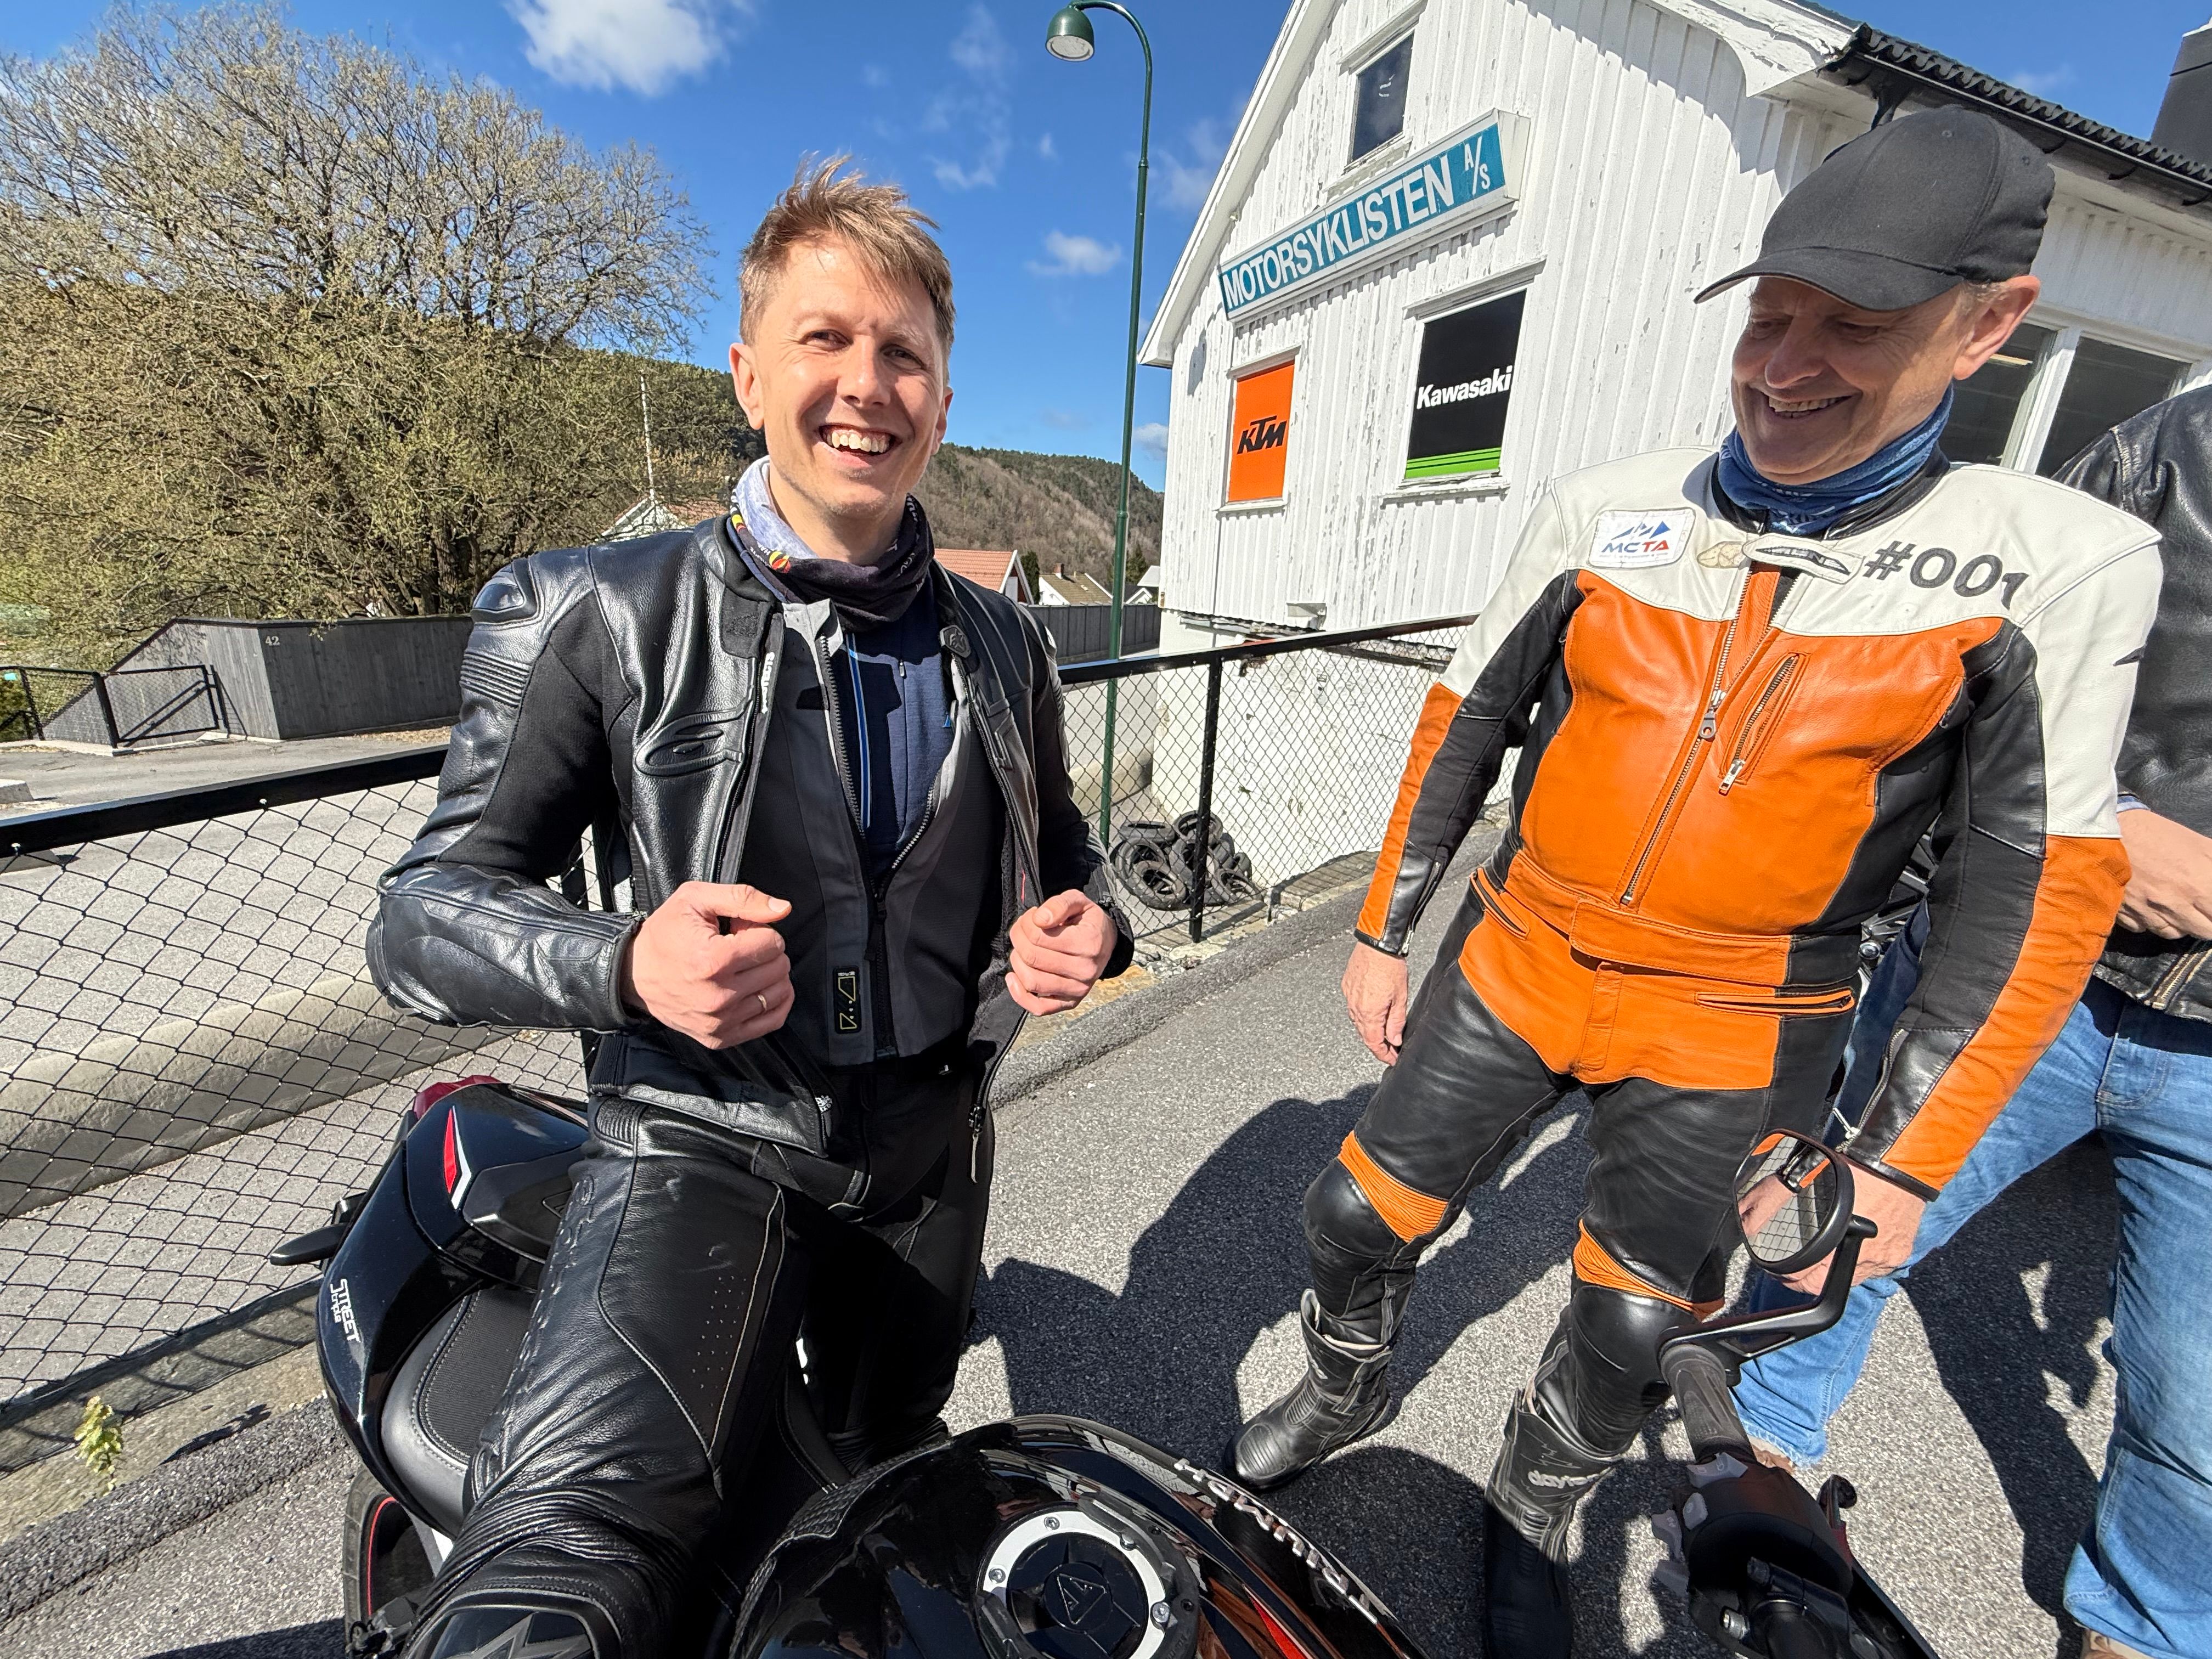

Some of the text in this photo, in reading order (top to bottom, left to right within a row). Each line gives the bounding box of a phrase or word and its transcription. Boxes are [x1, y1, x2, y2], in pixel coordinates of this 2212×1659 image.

[1223, 136, 1490, 309] MOTORSYKLISTEN A/S
[1417, 365, 1513, 409] Kawasaki
[1237, 415, 1287, 455] KTM
[1601, 540, 1669, 553] MCTA
[1863, 540, 2029, 610] #001
[265, 636, 280, 646] 42
[330, 1278, 361, 1343] STREET
[1174, 1458, 1378, 1624] TRIUMPH
